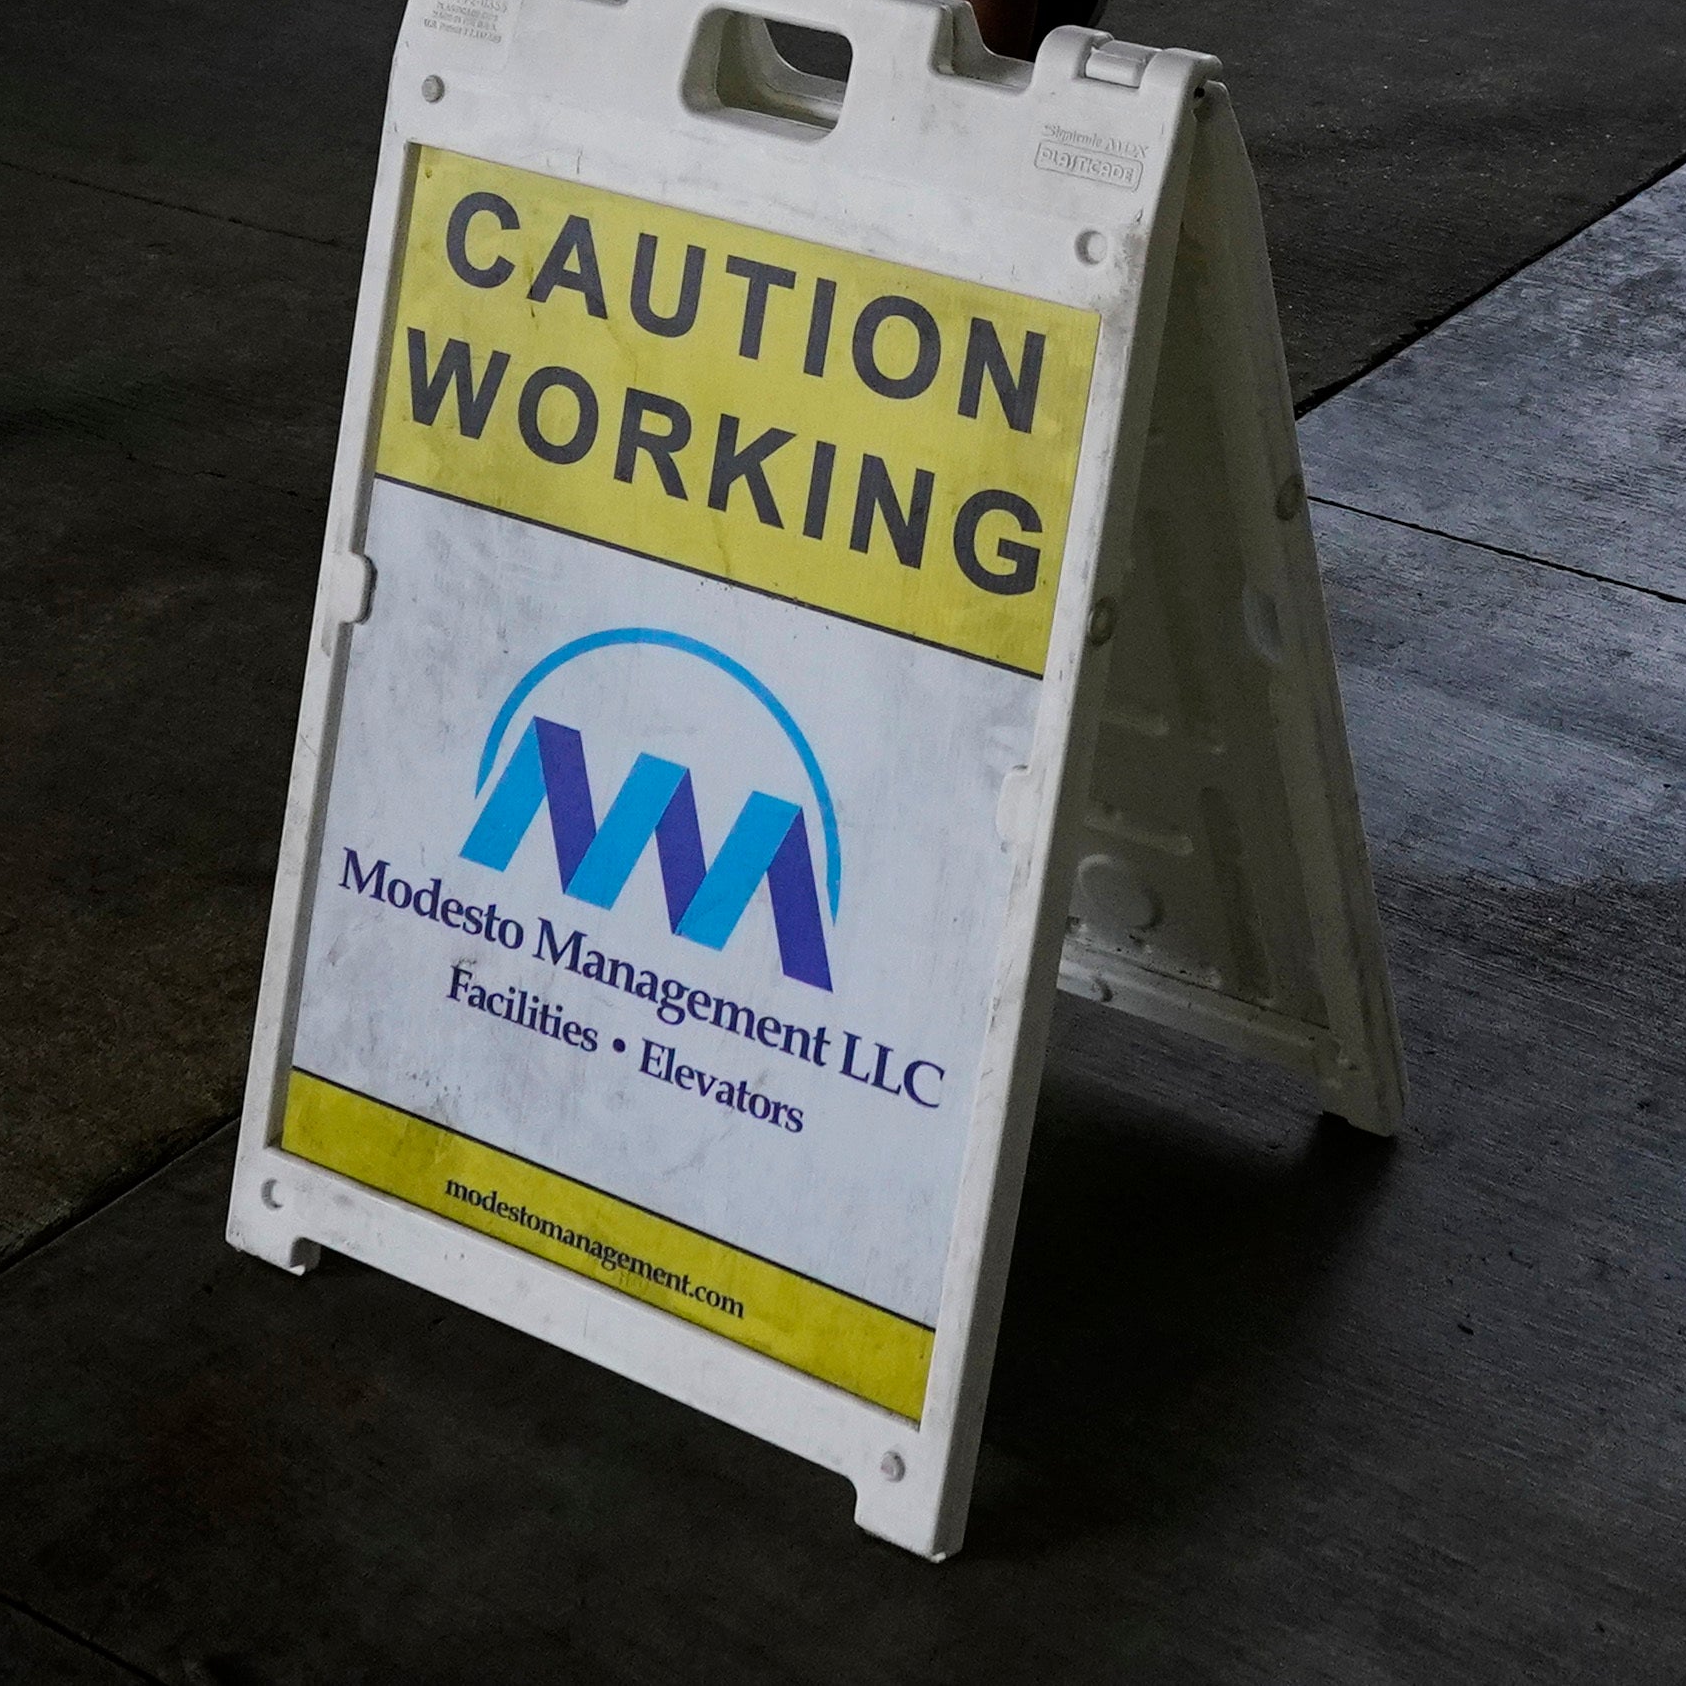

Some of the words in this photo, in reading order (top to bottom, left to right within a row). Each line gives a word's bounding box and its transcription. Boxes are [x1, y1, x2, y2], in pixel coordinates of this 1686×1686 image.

[445, 190, 1047, 434] CAUTION
[407, 326, 1043, 597] WORKING
[337, 845, 525, 950] Modesto
[531, 916, 832, 1069] Management
[838, 1029, 947, 1111] LLC
[446, 963, 599, 1054] Facilities
[637, 1036, 806, 1135] Elevators
[443, 1176, 745, 1320] modestomanagement.com
